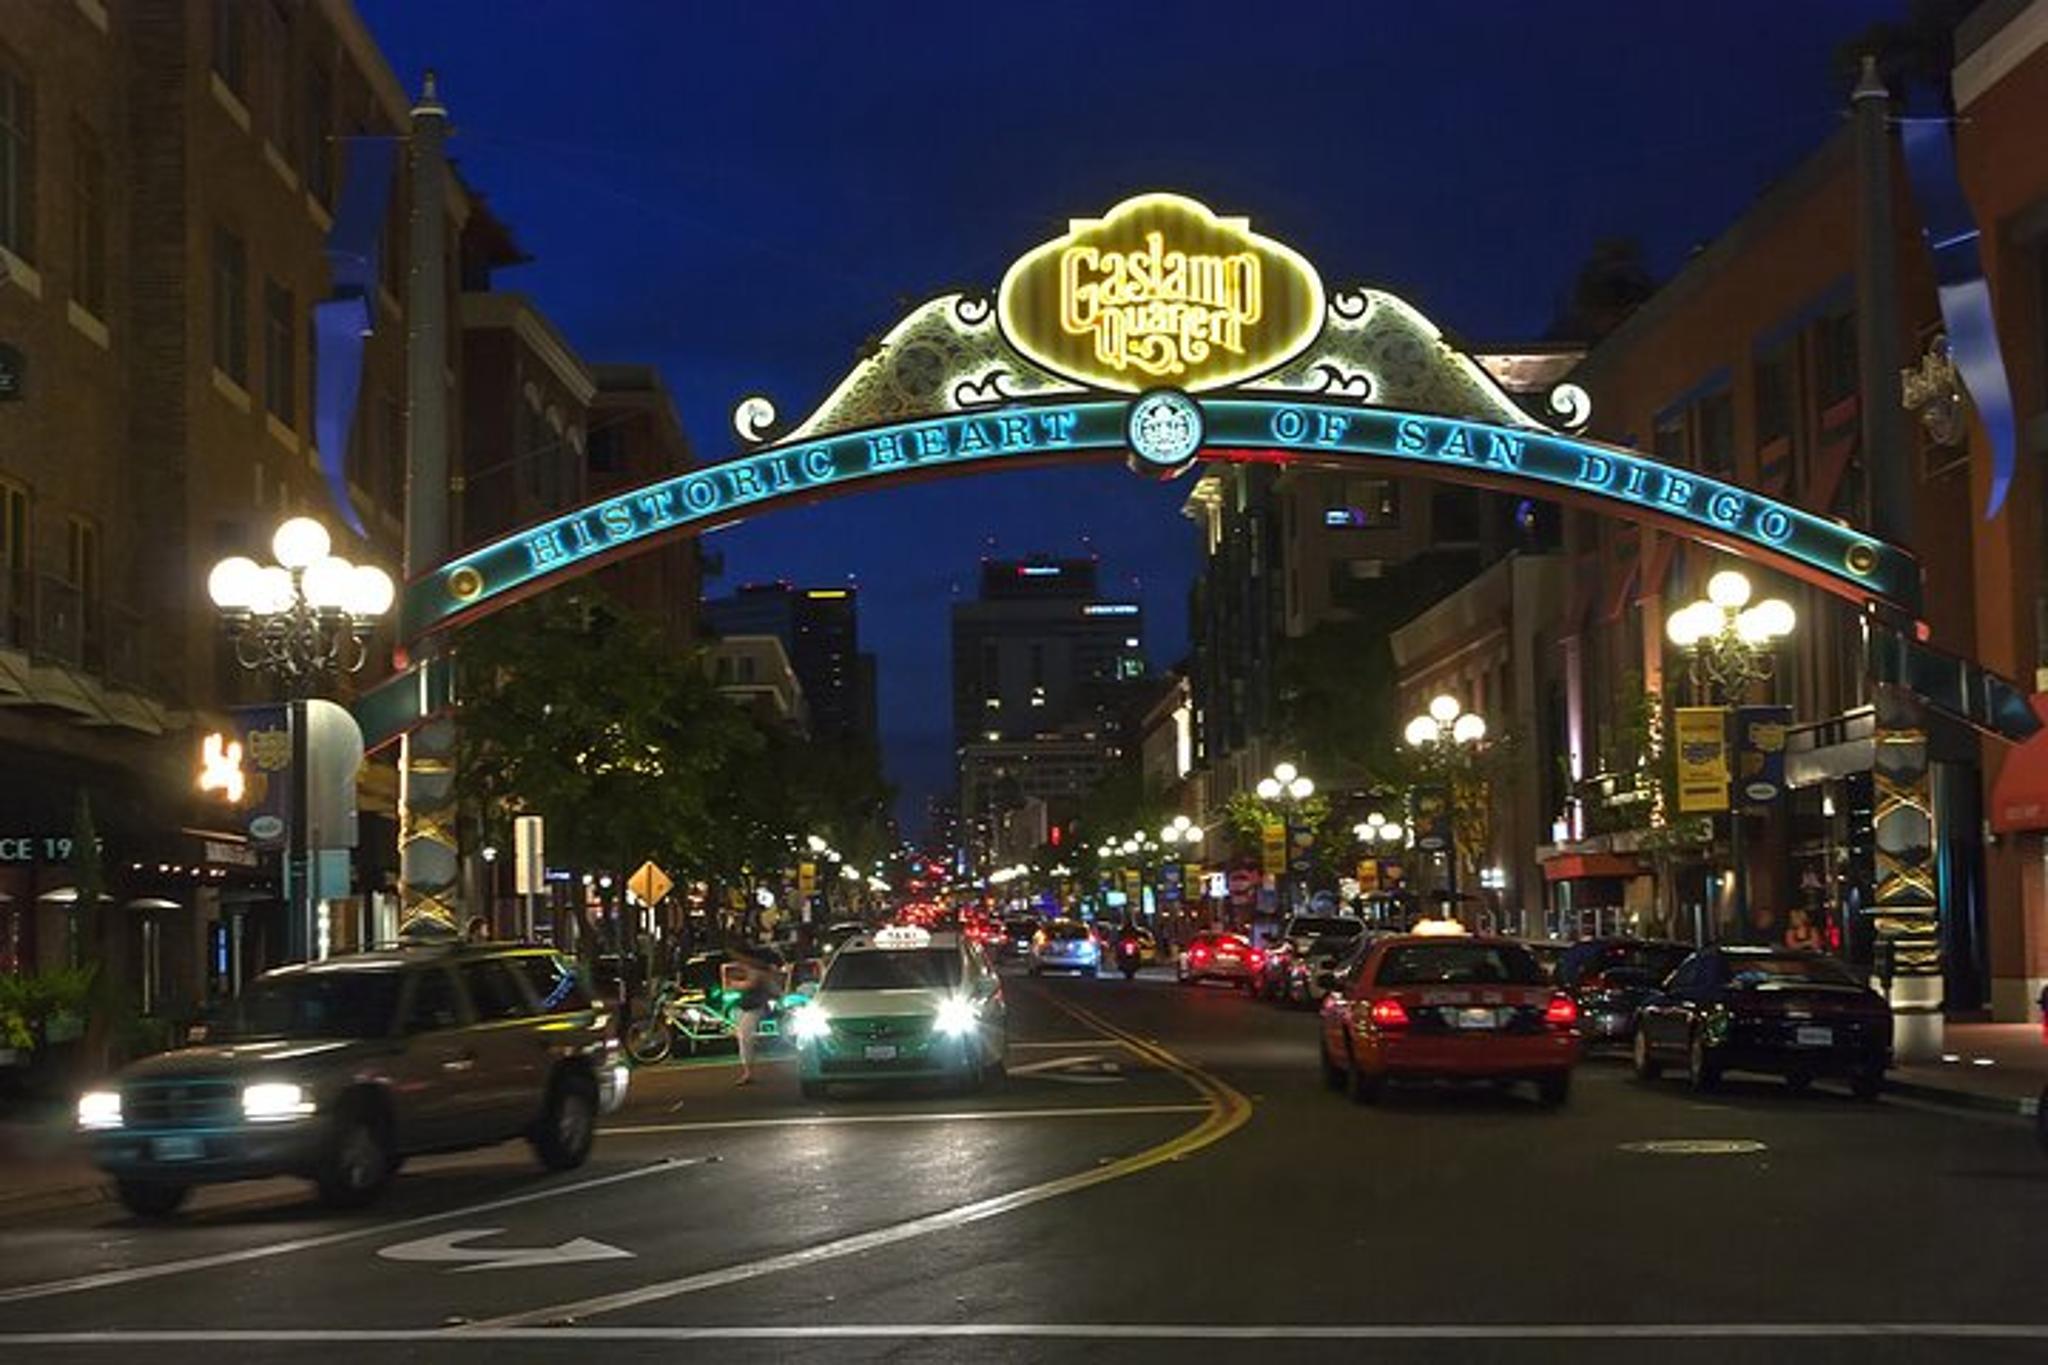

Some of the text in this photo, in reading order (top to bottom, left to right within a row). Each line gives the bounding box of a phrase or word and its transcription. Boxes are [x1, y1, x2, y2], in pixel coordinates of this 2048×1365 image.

[1060, 230, 1262, 335] Gaslamp
[1094, 302, 1246, 375] Quarter
[526, 446, 835, 573] HISTORIC
[866, 410, 1077, 470] HEART
[1271, 406, 1349, 447] OF
[1396, 415, 1525, 470] SAN
[1576, 453, 1793, 545] DIEGO
